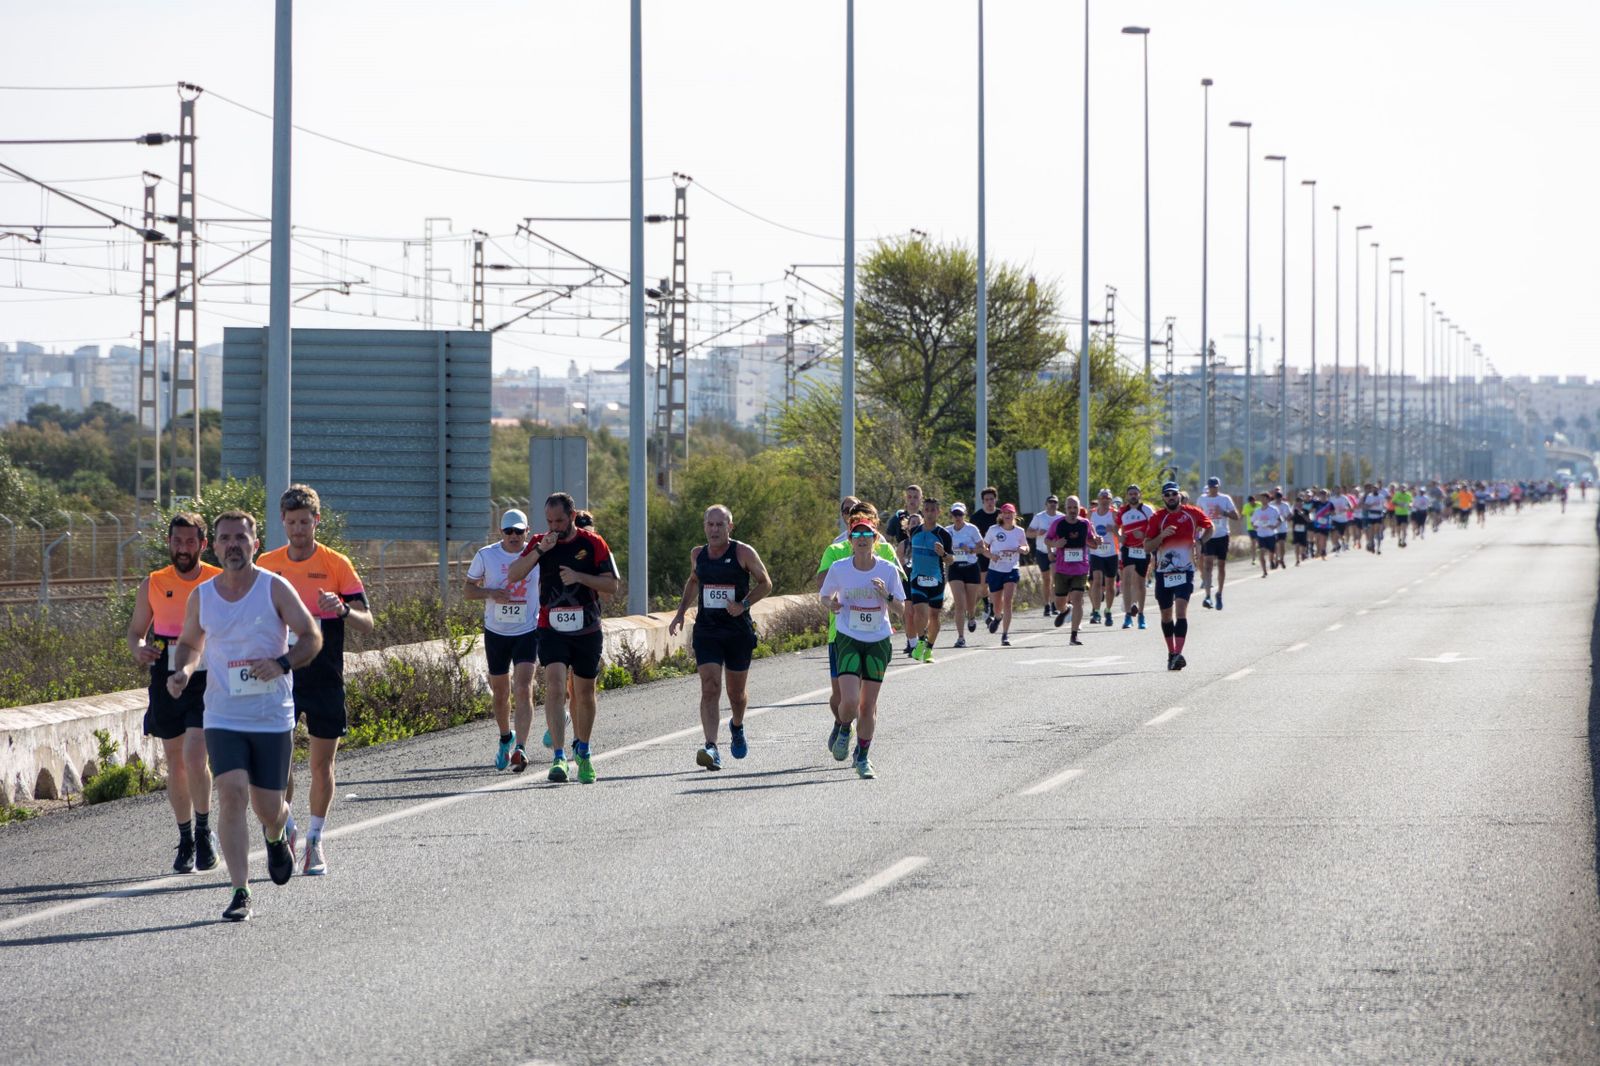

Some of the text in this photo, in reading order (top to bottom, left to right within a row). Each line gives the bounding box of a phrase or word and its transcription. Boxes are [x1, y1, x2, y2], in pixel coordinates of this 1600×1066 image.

[710, 590, 728, 599] 655
[501, 605, 520, 615] 512
[556, 612, 576, 622] 634
[860, 612, 872, 623] 66
